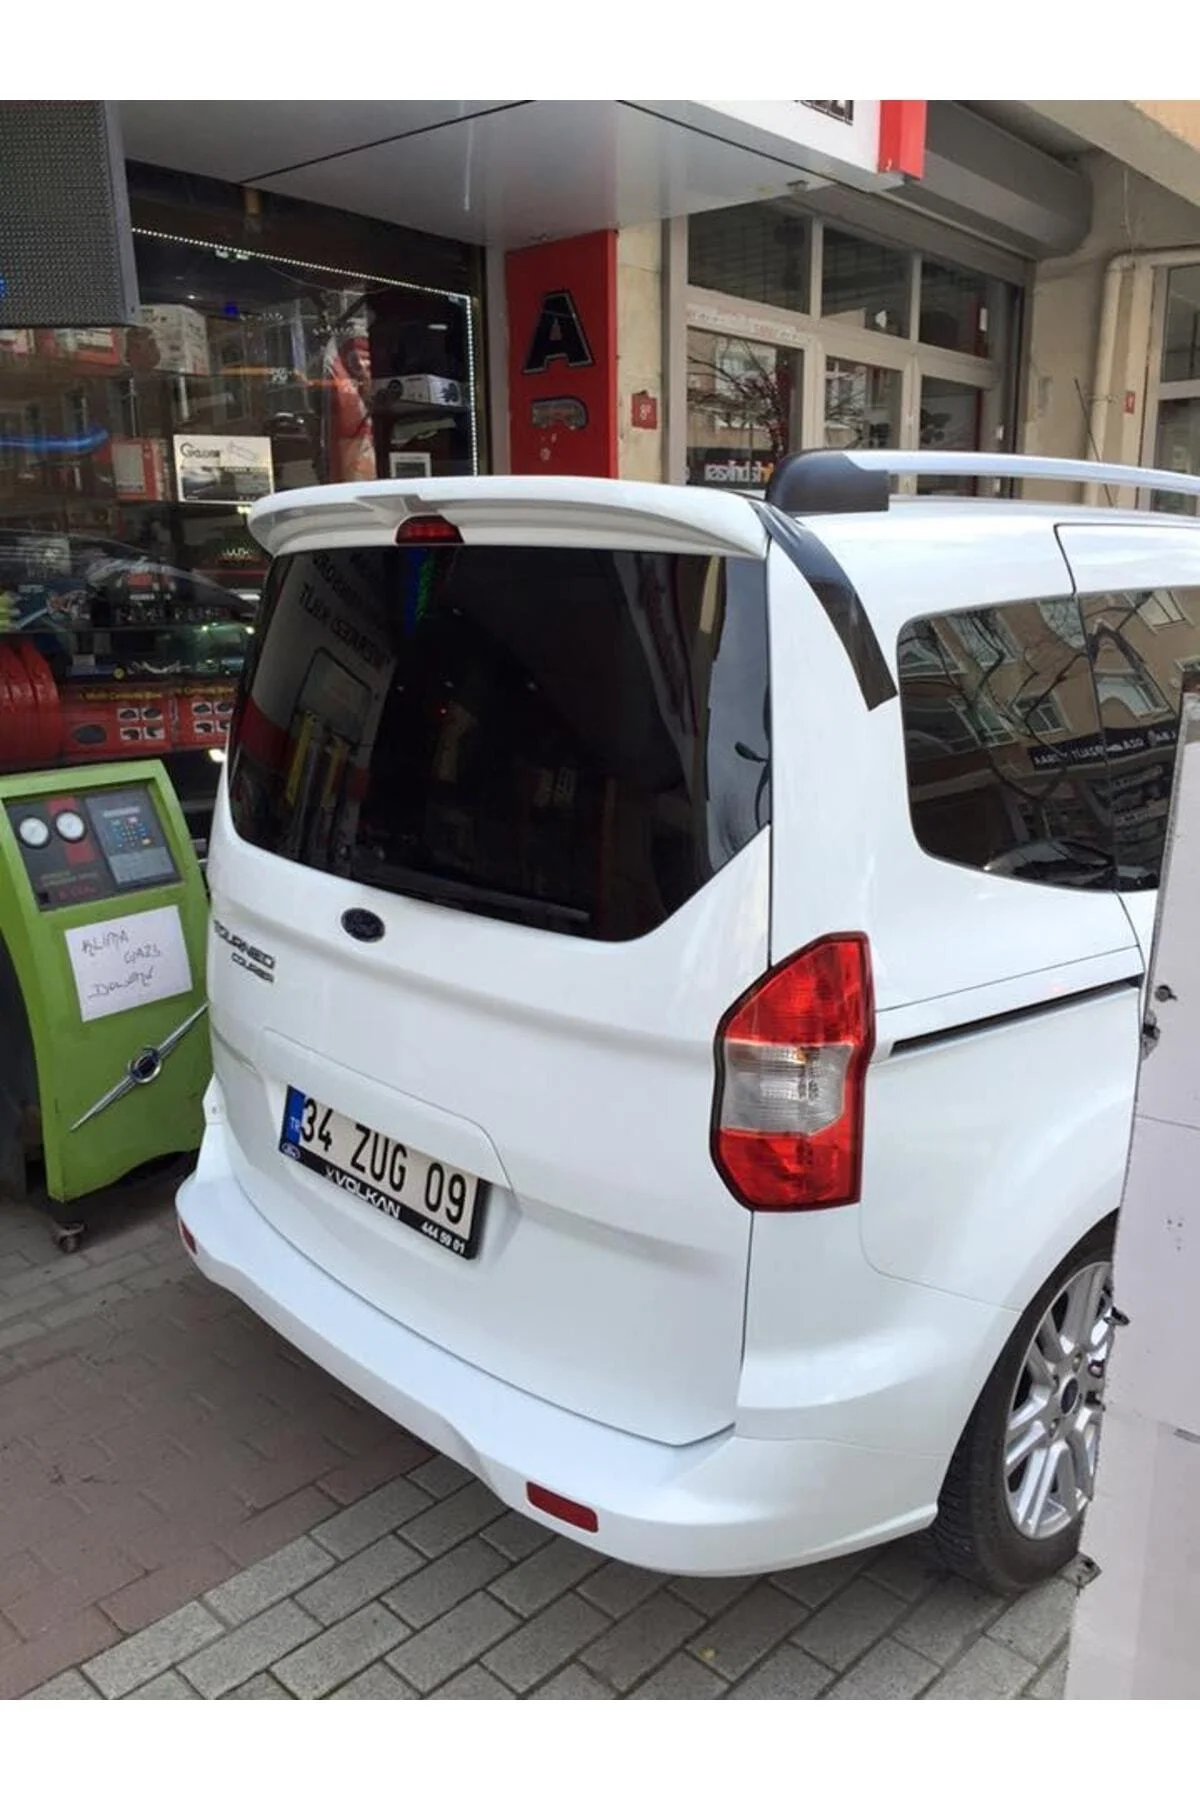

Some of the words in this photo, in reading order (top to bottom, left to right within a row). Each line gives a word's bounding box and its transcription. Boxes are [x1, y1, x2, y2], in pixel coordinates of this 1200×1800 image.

[522, 289, 594, 374] A
[300, 1098, 333, 1151] 34
[350, 1123, 407, 1191] ZUG
[425, 1162, 466, 1224] 09
